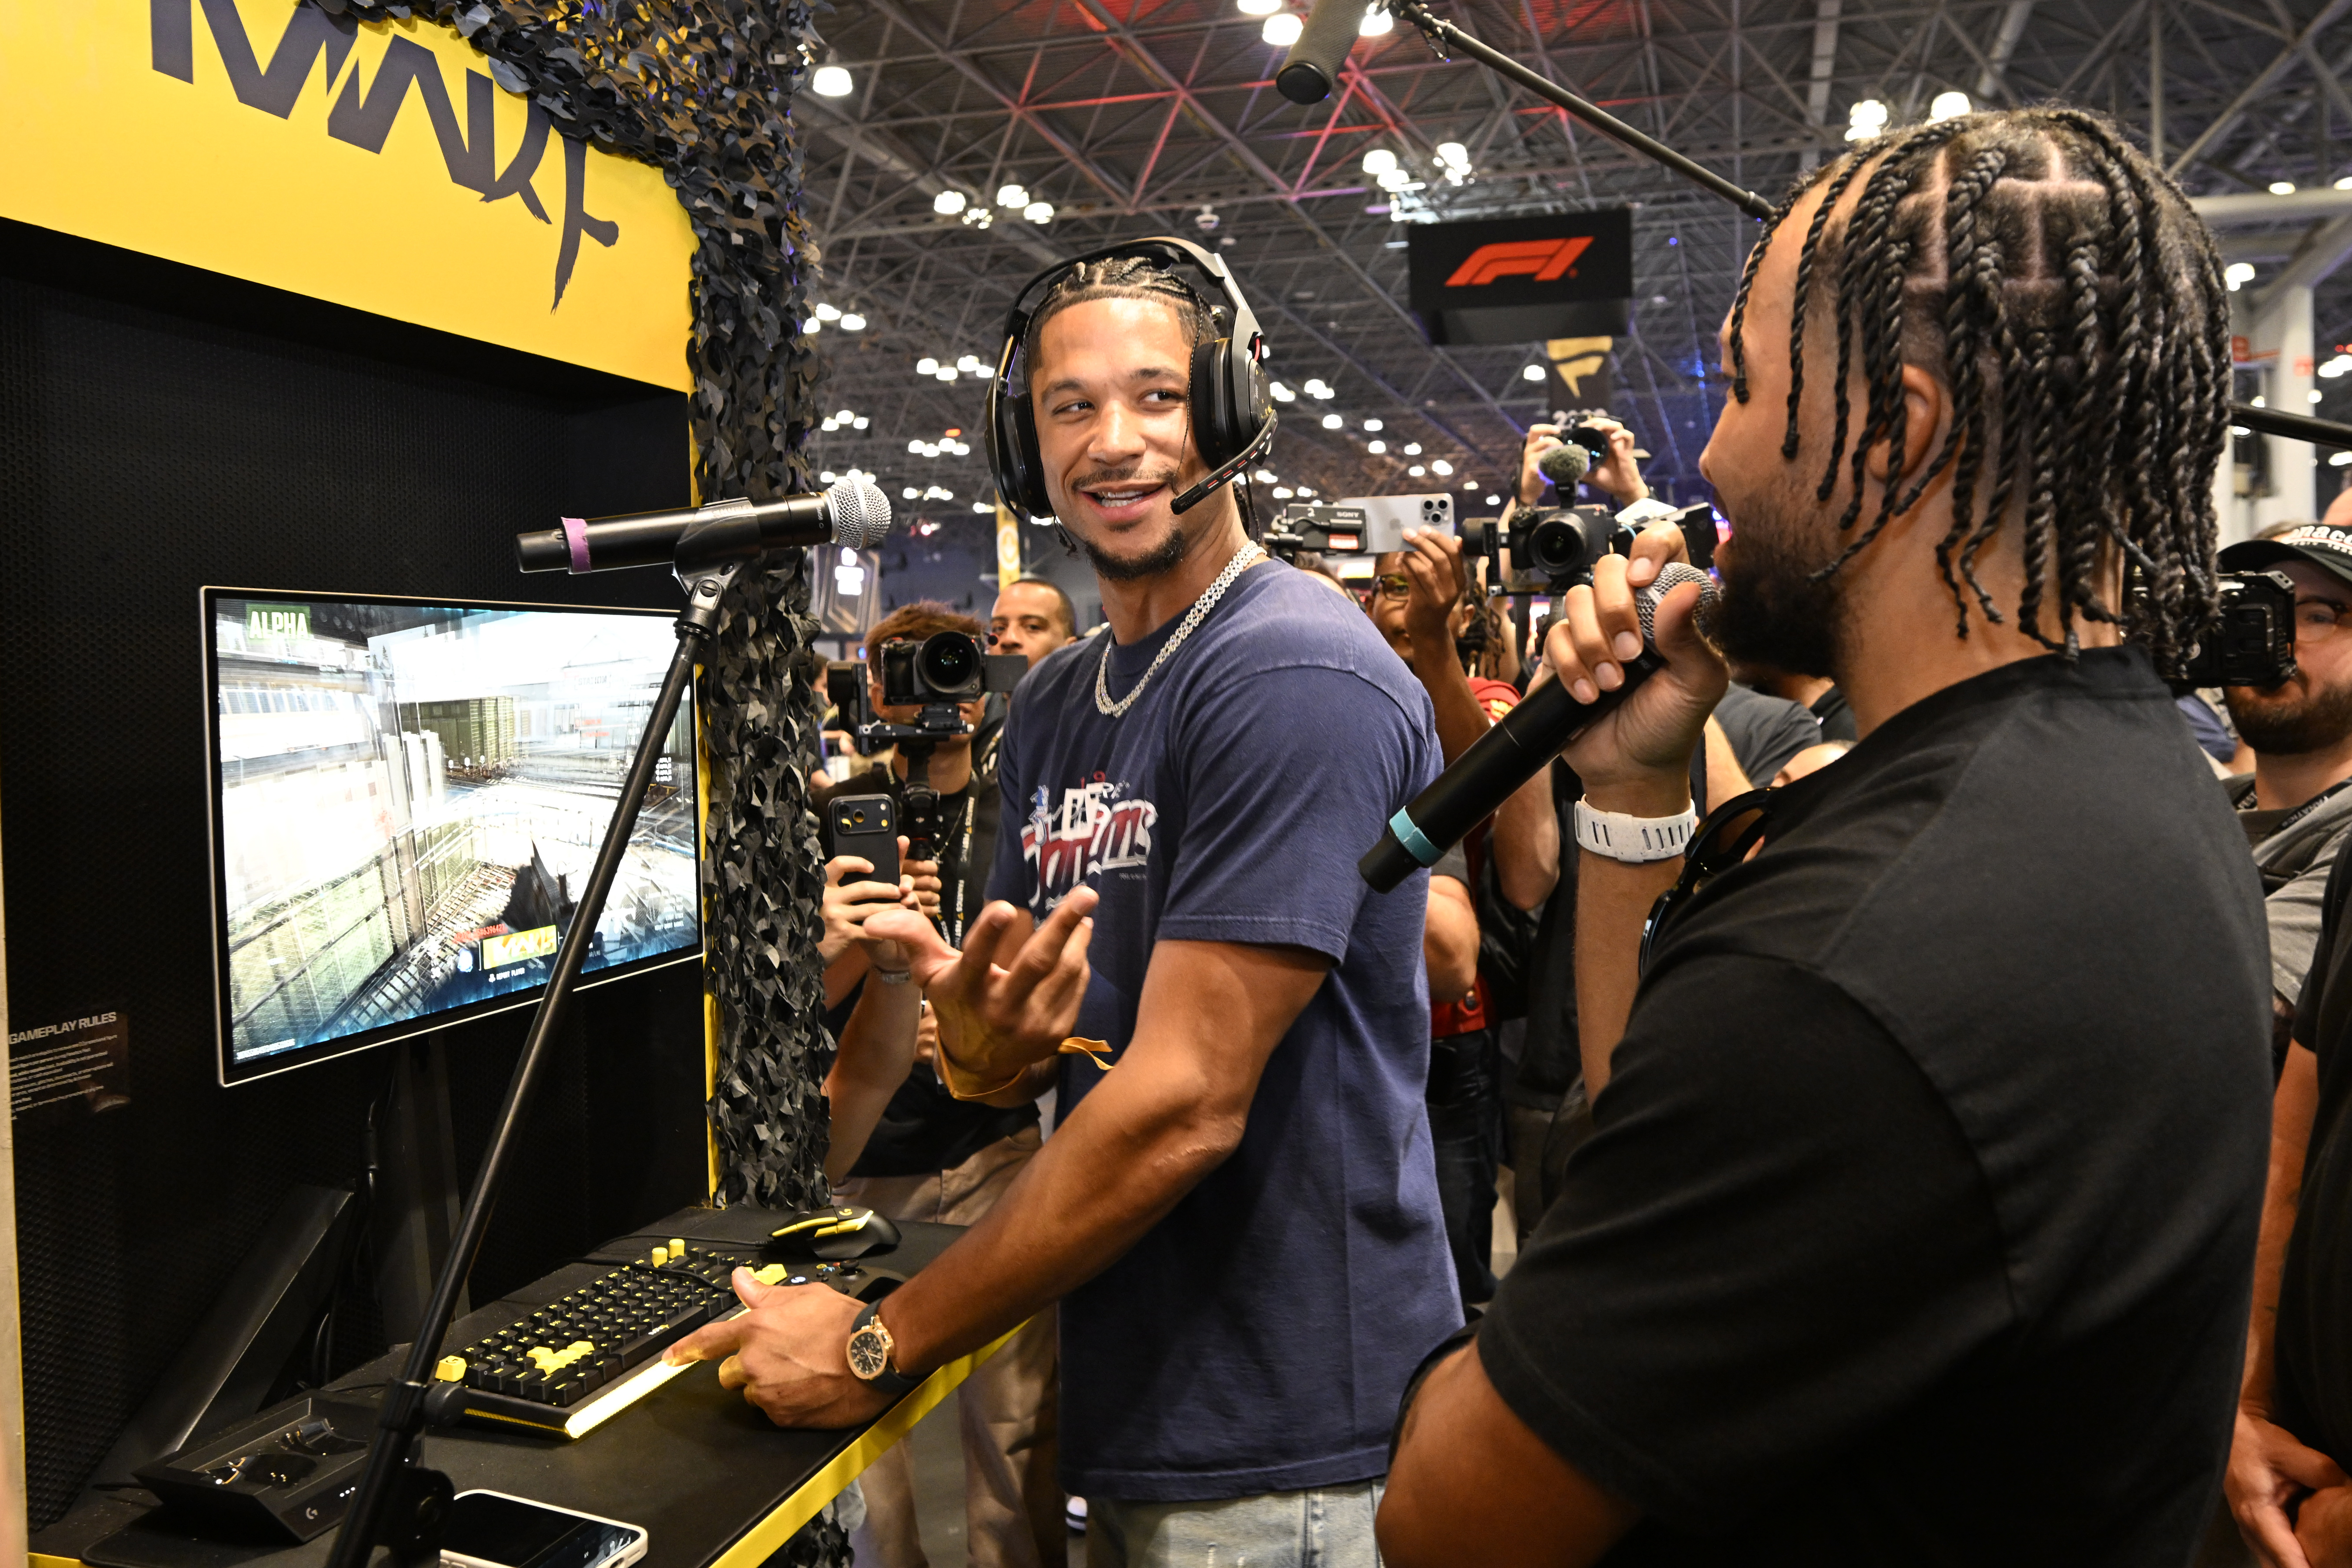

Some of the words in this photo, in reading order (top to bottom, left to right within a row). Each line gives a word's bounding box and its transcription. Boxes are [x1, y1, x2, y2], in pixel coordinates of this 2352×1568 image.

[1444, 236, 1593, 287] F1
[249, 611, 309, 640] ALPHA
[511, 967, 525, 977] PLAYER
[8, 1020, 77, 1045] GAMEPLAY
[78, 1011, 117, 1029] RULES
